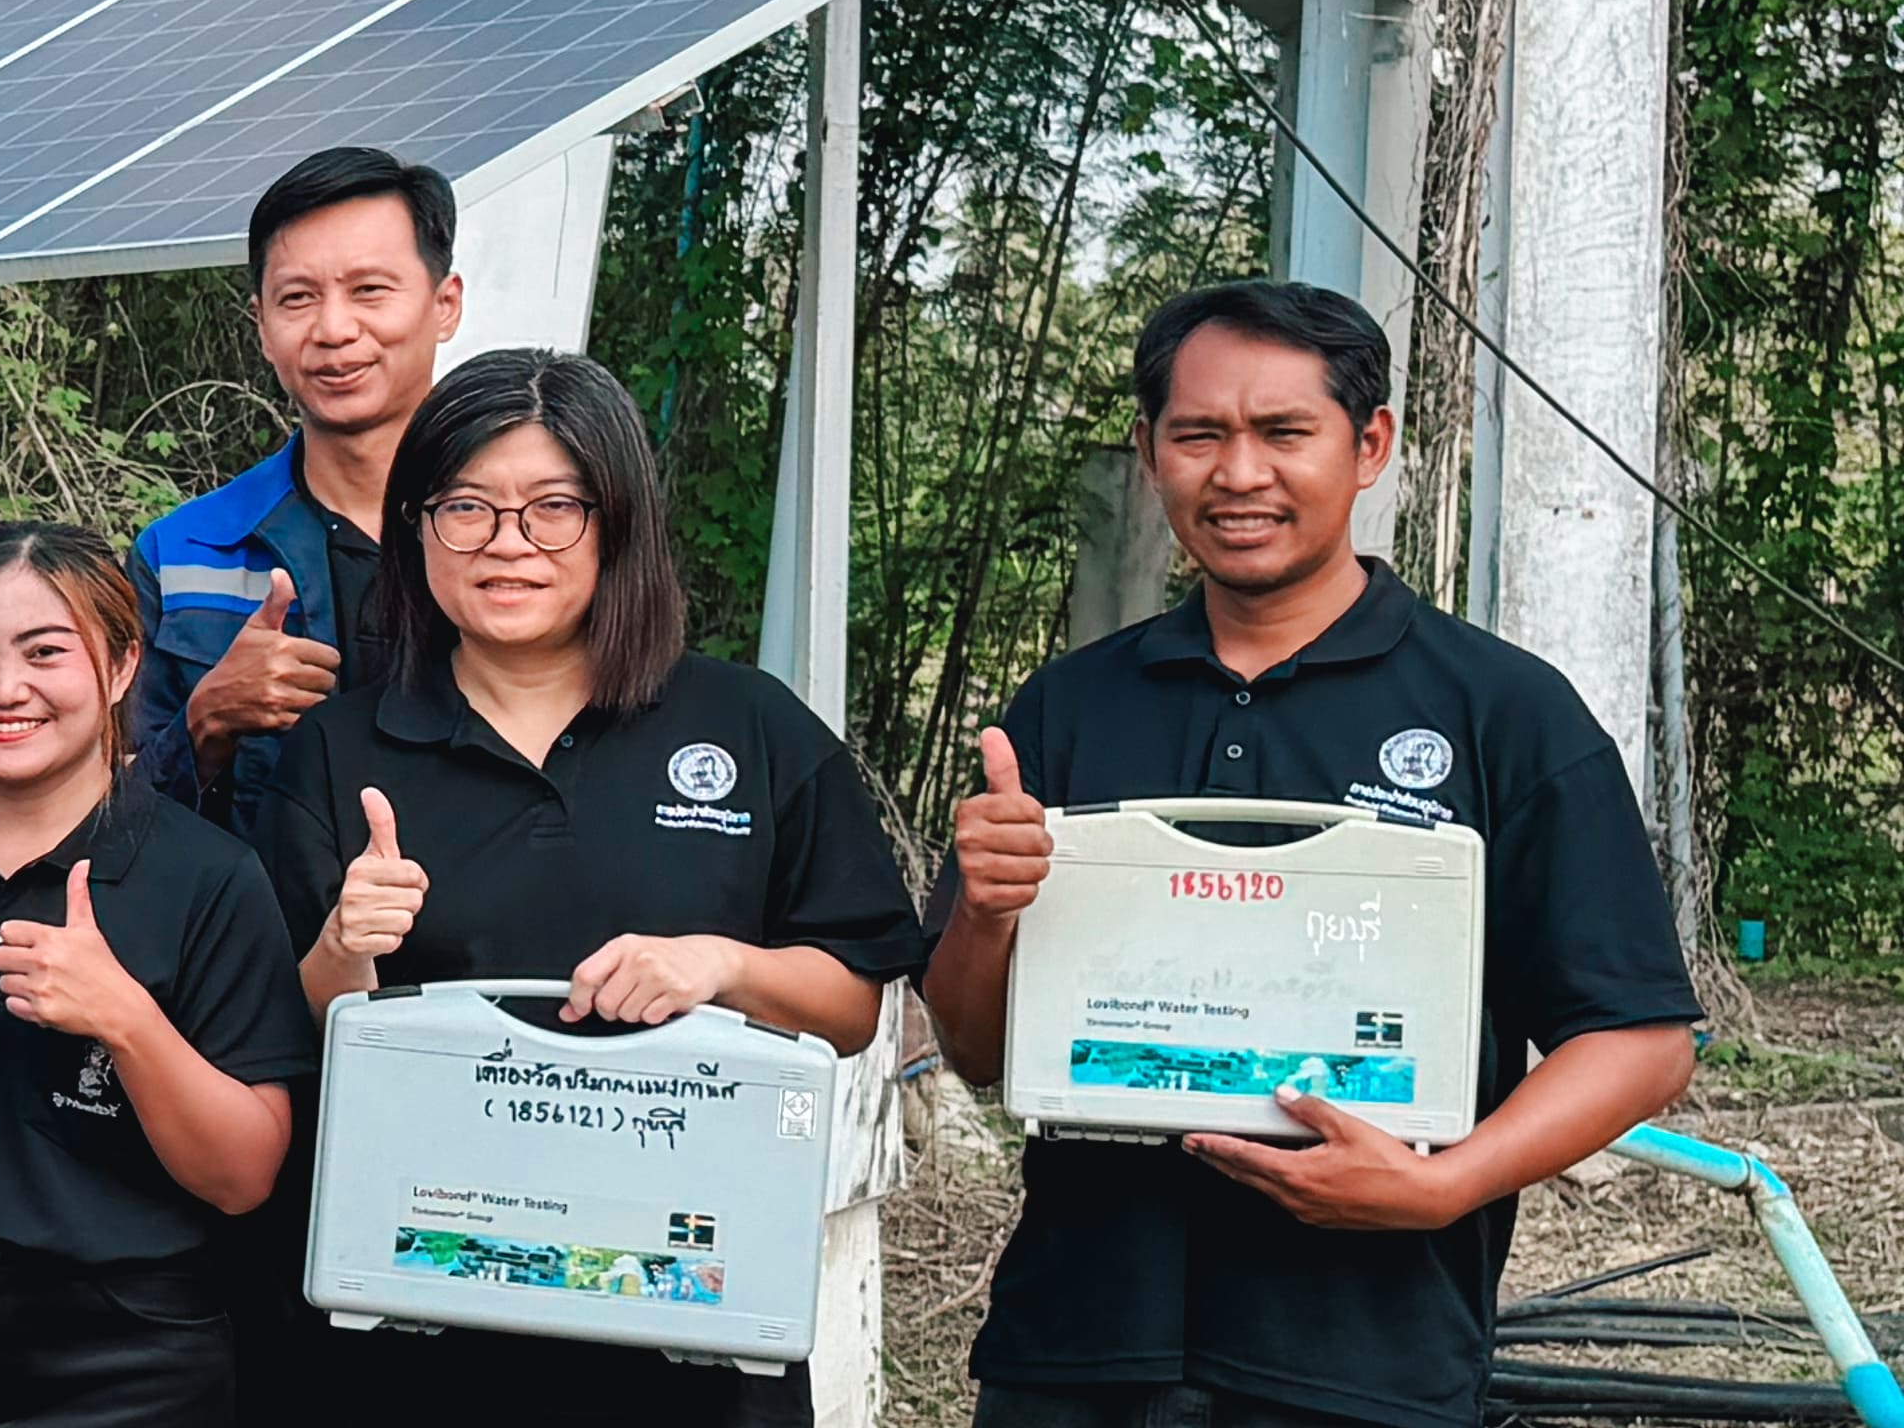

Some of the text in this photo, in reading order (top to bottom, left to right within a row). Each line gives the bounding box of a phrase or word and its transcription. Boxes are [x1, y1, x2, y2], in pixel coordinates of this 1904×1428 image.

[1168, 871, 1285, 902] 1856120
[1305, 890, 1383, 962] กุยบุรี
[1158, 1000, 1199, 1016] Water
[1202, 1003, 1250, 1020] Testing
[481, 1193, 520, 1208] Water
[523, 1196, 568, 1214] Testing
